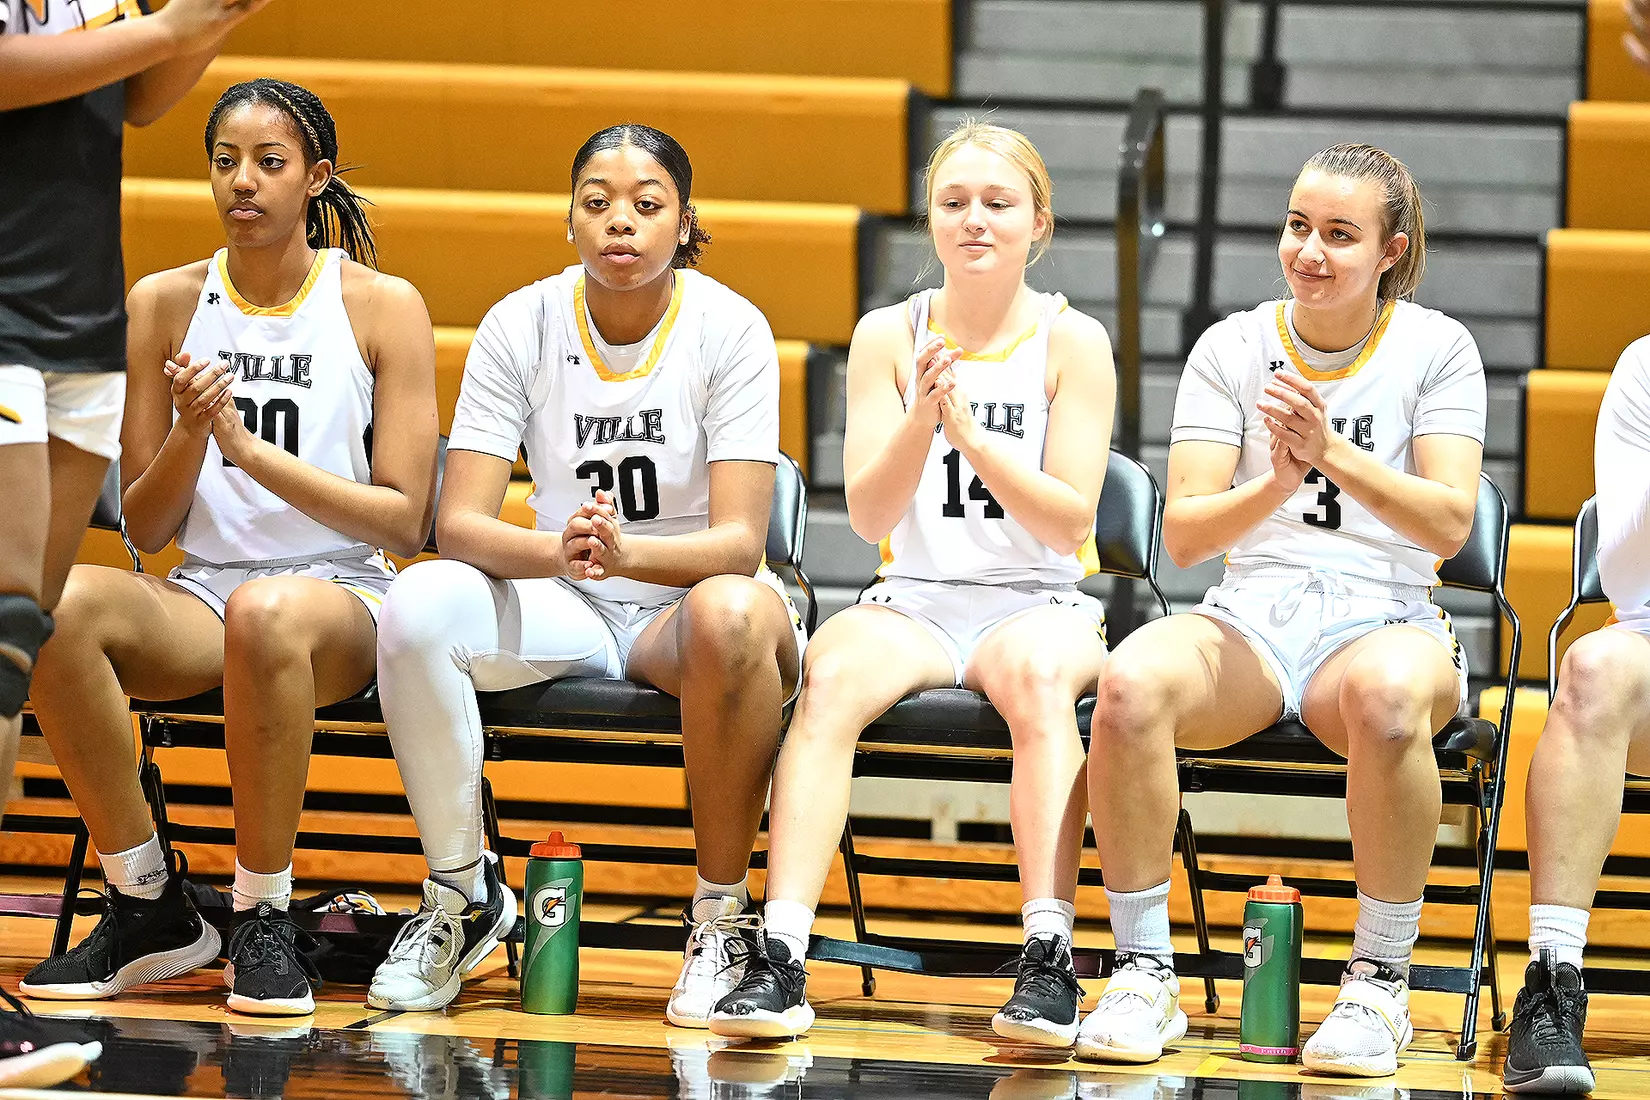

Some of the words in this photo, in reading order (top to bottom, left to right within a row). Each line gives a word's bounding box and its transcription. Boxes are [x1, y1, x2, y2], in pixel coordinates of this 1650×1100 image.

[218, 350, 312, 389] VILLE
[574, 408, 665, 449] VILLE
[575, 455, 660, 522] 30
[1302, 466, 1341, 530] 3
[532, 886, 567, 928] G
